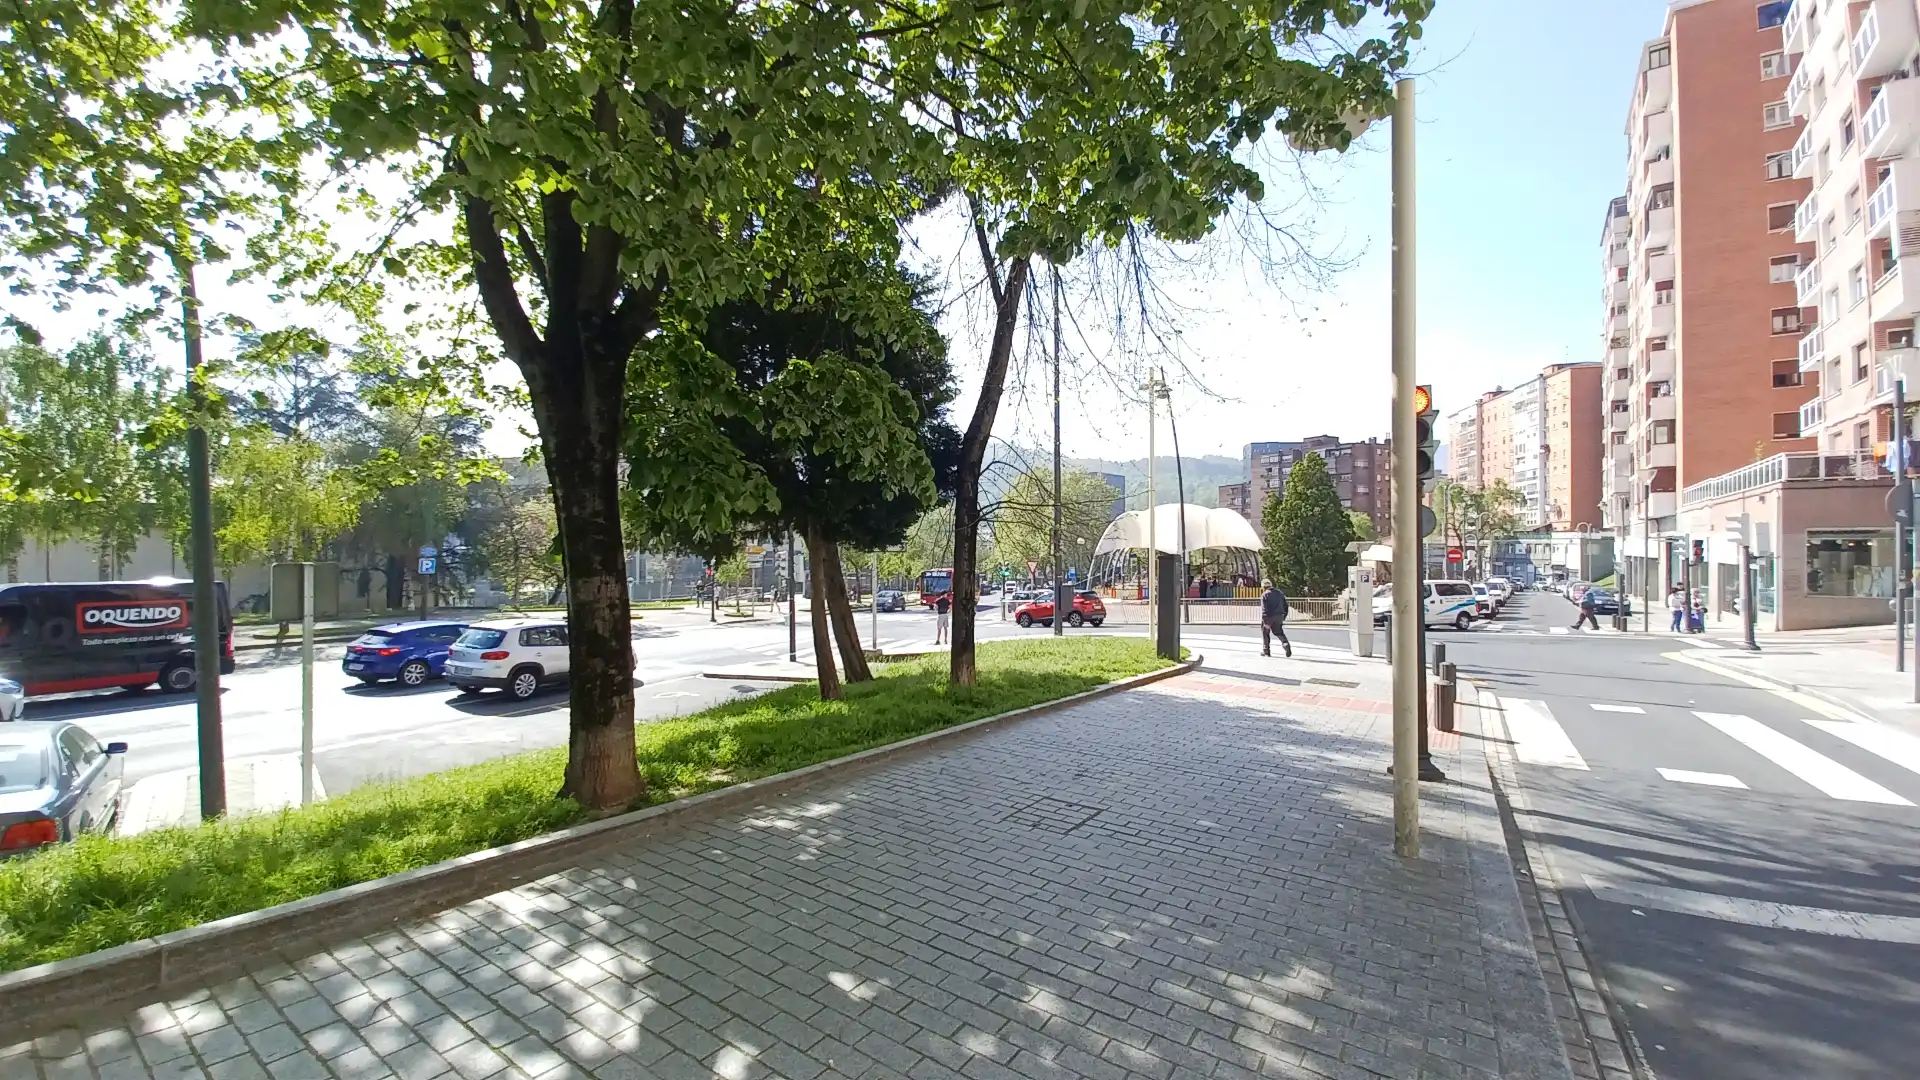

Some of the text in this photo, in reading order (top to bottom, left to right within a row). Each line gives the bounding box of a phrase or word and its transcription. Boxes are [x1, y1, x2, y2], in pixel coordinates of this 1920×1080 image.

[422, 560, 433, 572] P
[85, 606, 181, 627] OQUENDO
[82, 638, 102, 646] Todo
[103, 637, 138, 645] empieza
